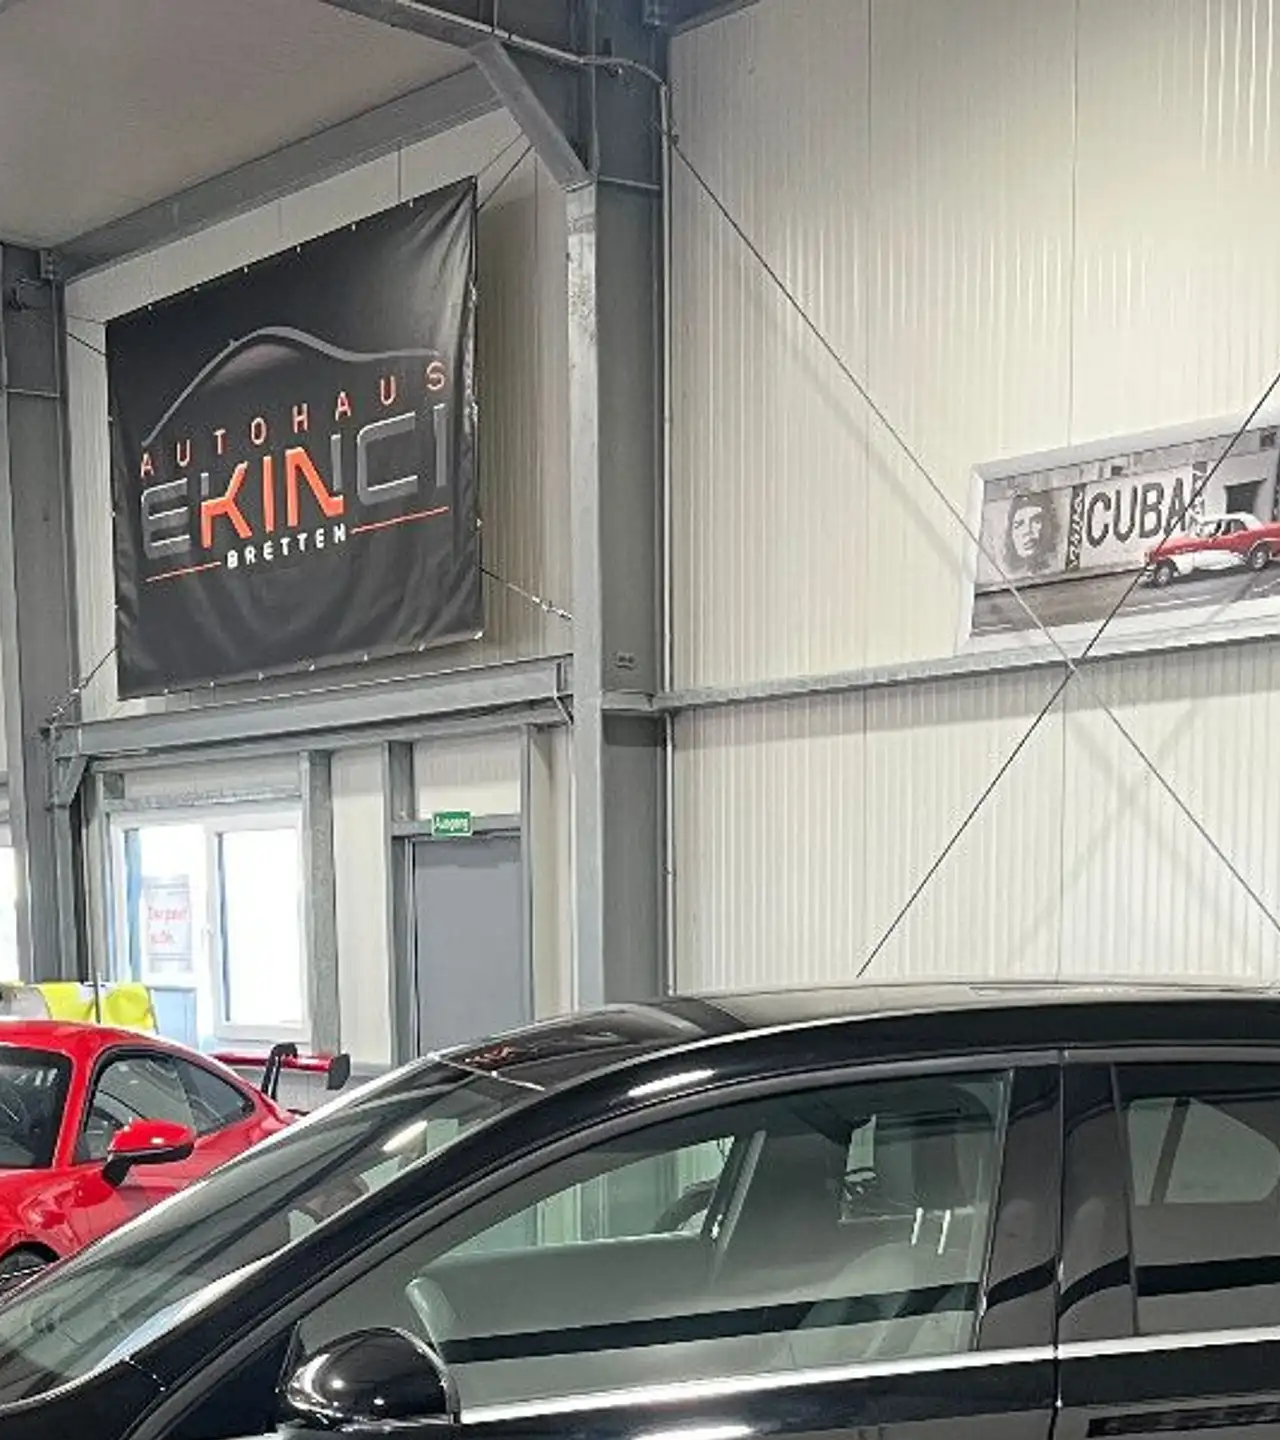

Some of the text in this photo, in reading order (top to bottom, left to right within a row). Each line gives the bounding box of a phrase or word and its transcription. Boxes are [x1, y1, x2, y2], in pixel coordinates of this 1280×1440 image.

[140, 360, 448, 478] AUTOHAUS
[140, 403, 450, 560] EKINCI
[1086, 477, 1187, 548] CUBA
[226, 524, 348, 570] BRETTEN
